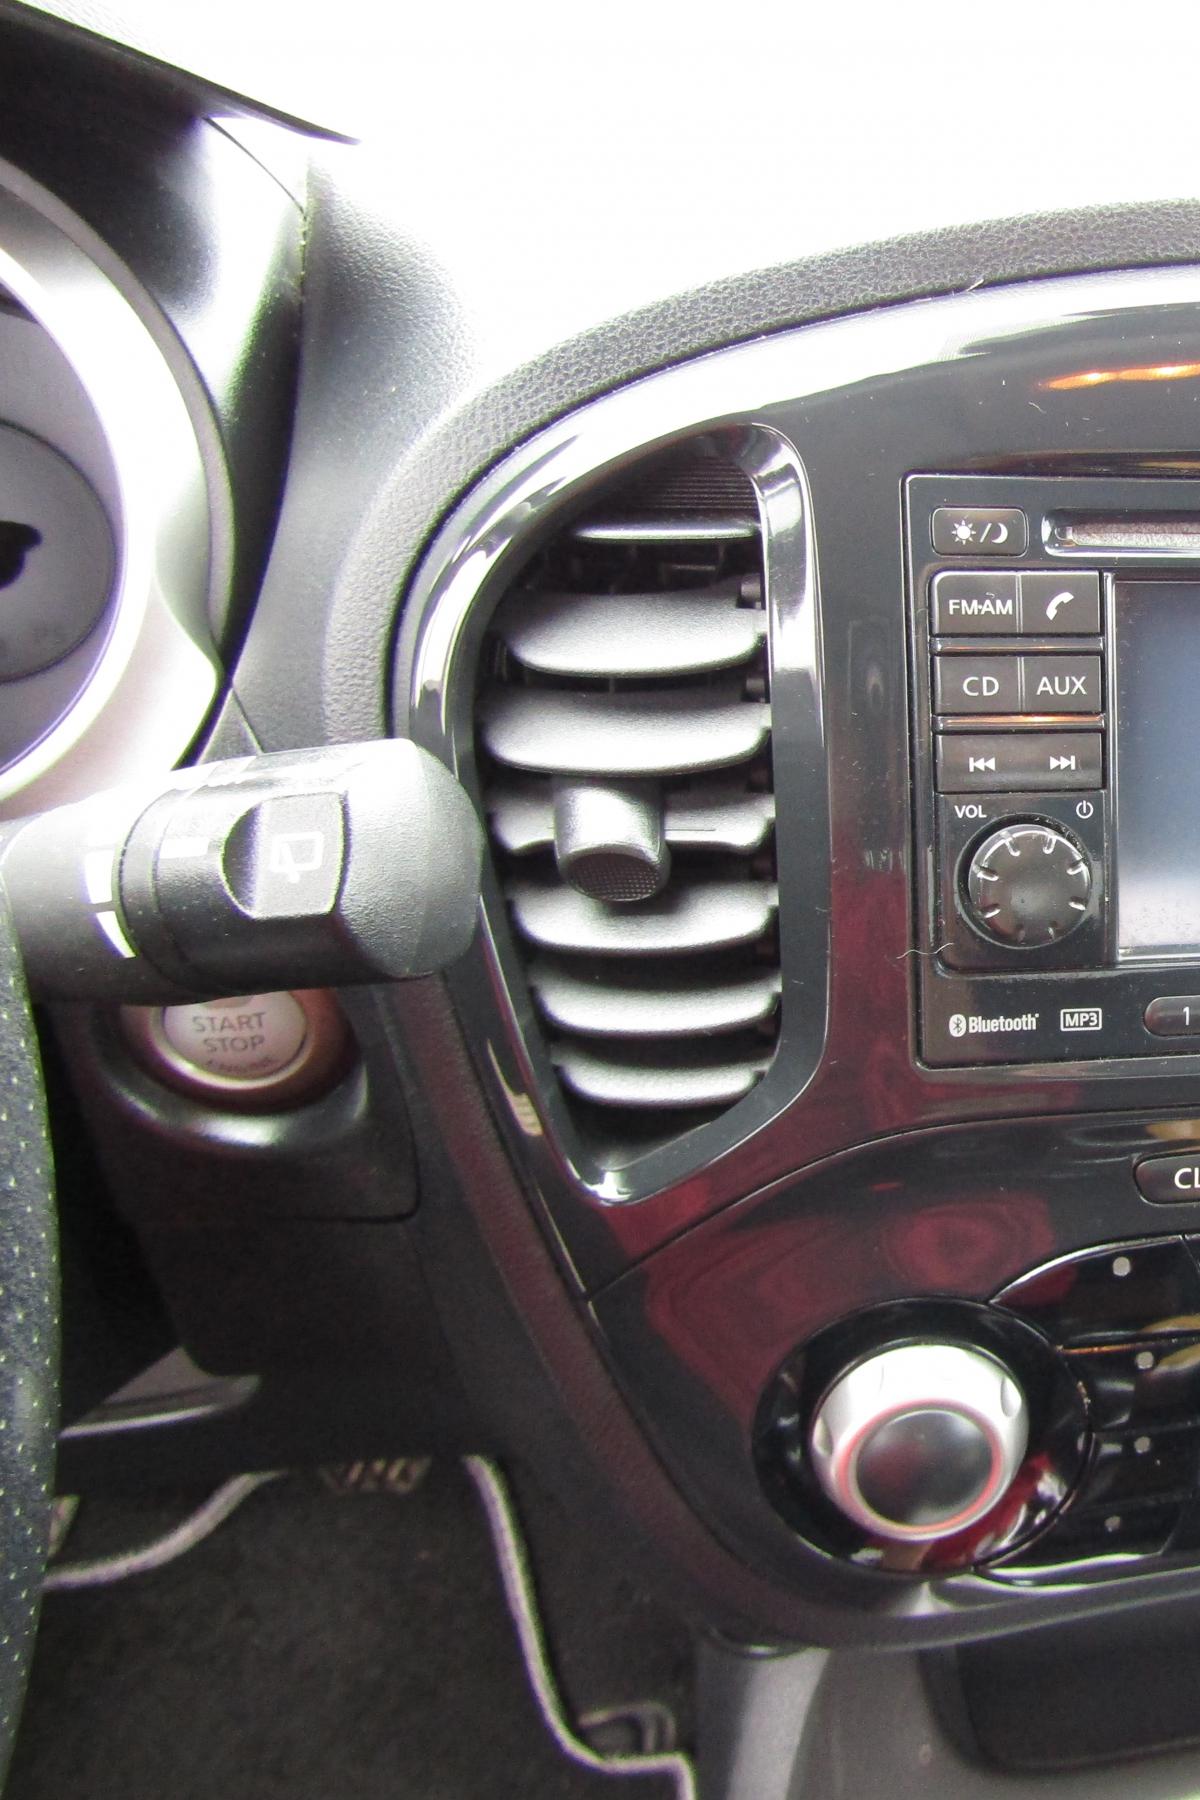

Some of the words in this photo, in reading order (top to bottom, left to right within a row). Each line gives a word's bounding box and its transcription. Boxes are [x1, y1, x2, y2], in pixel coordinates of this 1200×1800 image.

[962, 676, 999, 696] CD
[1036, 676, 1087, 695] AUX
[954, 804, 987, 819] VOL
[191, 1011, 267, 1032] START
[968, 1013, 1038, 1033] Bluetooth
[1064, 1012, 1098, 1027] MP3
[1182, 1006, 1190, 1025] 1
[203, 1034, 266, 1053] STOP
